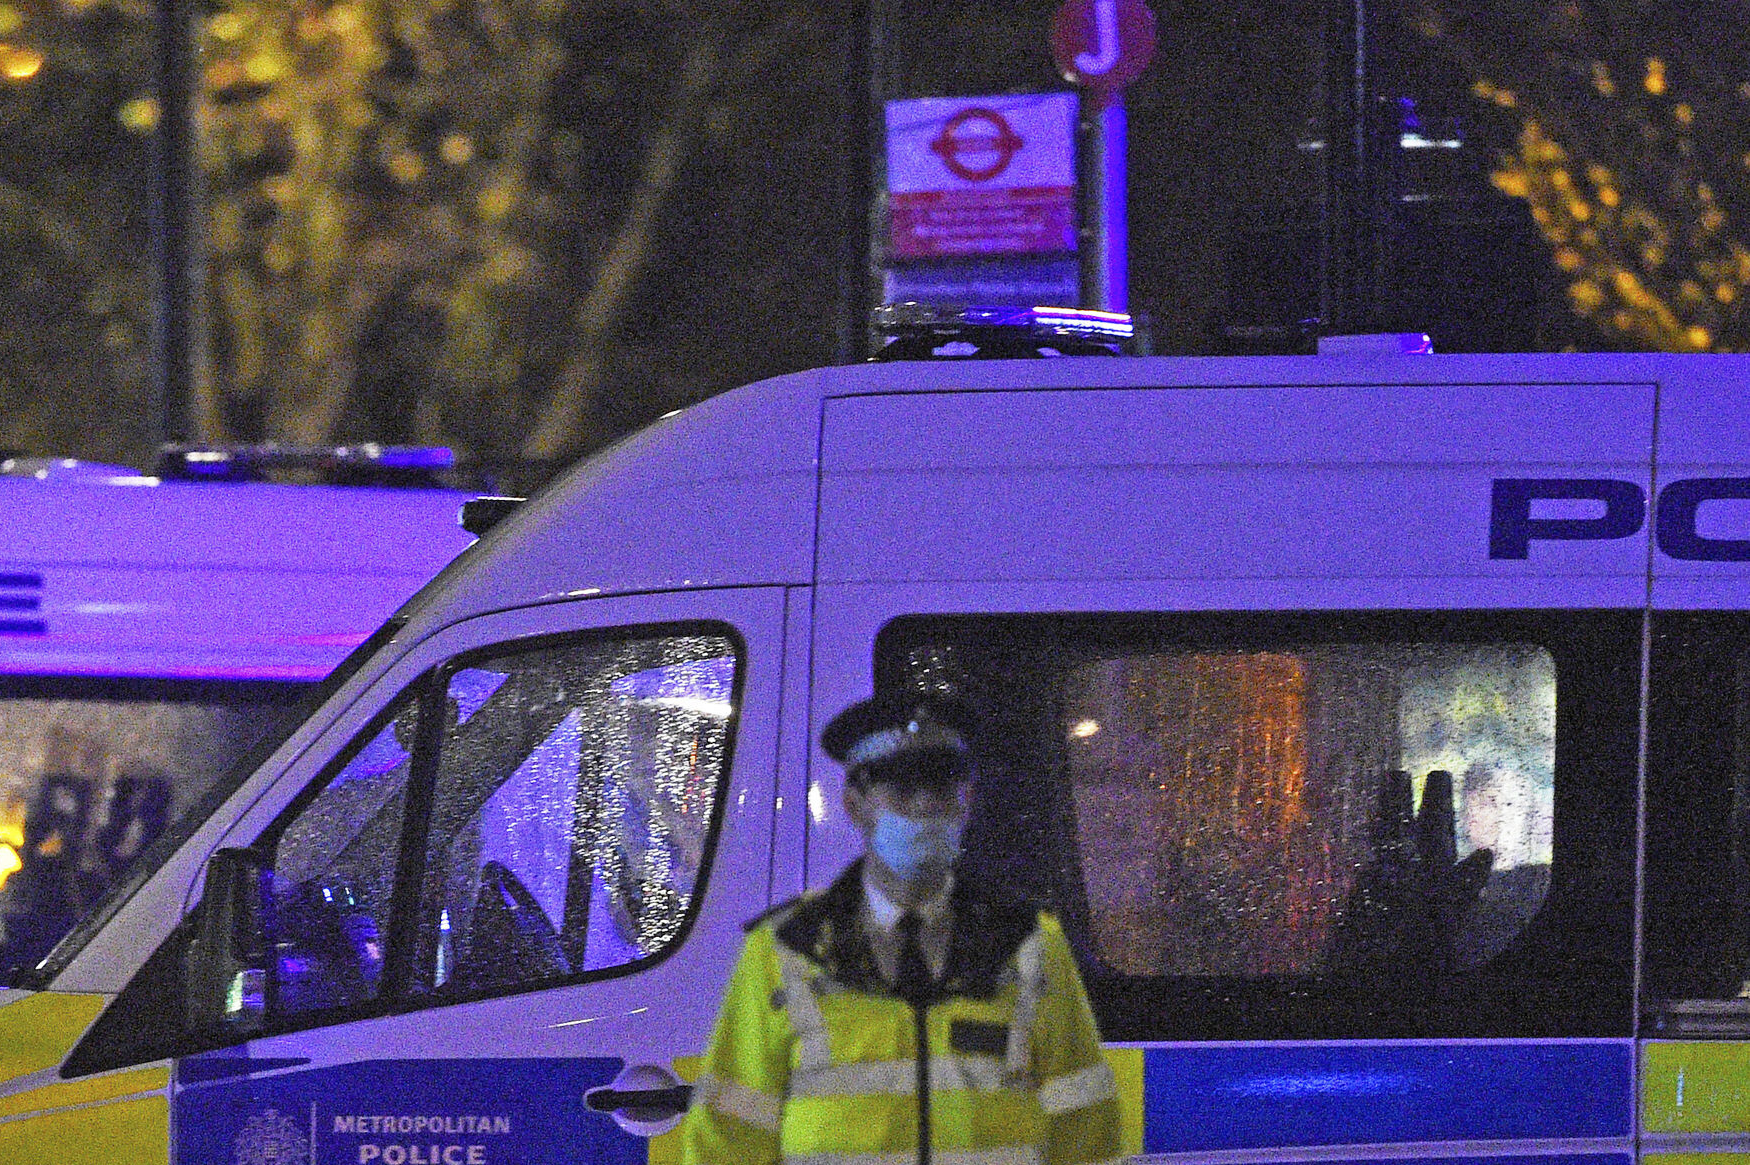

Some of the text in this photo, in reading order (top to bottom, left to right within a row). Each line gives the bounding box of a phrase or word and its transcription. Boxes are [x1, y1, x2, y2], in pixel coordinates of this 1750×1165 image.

[1074, 0, 1119, 75] J
[333, 1114, 511, 1135] METROPOLITAN
[358, 1143, 487, 1165] POLICE
